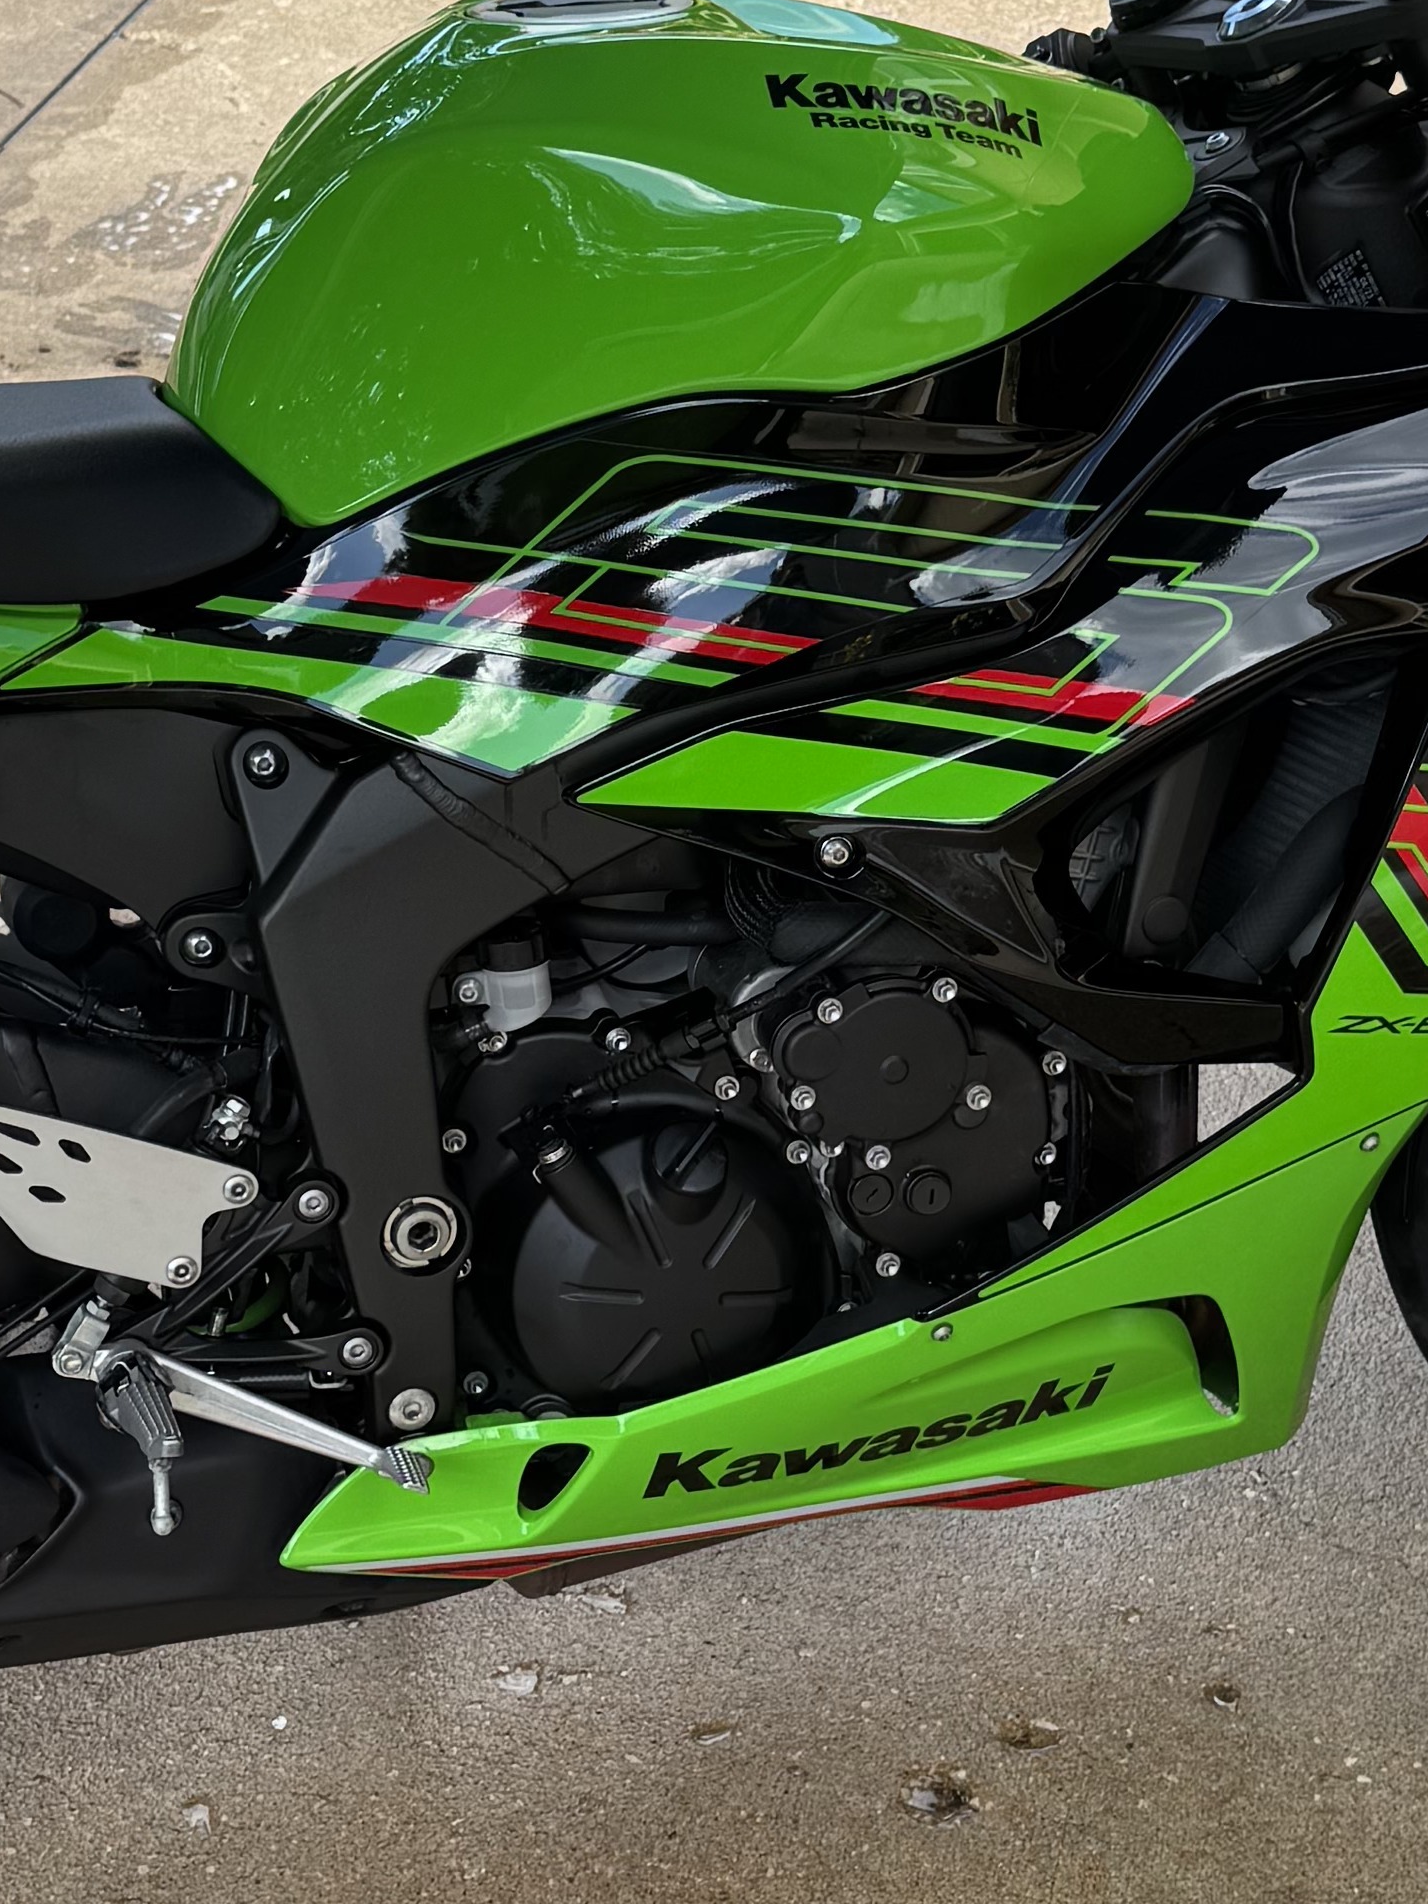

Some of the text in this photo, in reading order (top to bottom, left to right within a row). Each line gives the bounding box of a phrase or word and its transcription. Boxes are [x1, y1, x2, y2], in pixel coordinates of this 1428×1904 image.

[764, 73, 1043, 147] Kawasaki
[809, 111, 1023, 159] Racing Team
[642, 1362, 1116, 1500] Kawasaki
